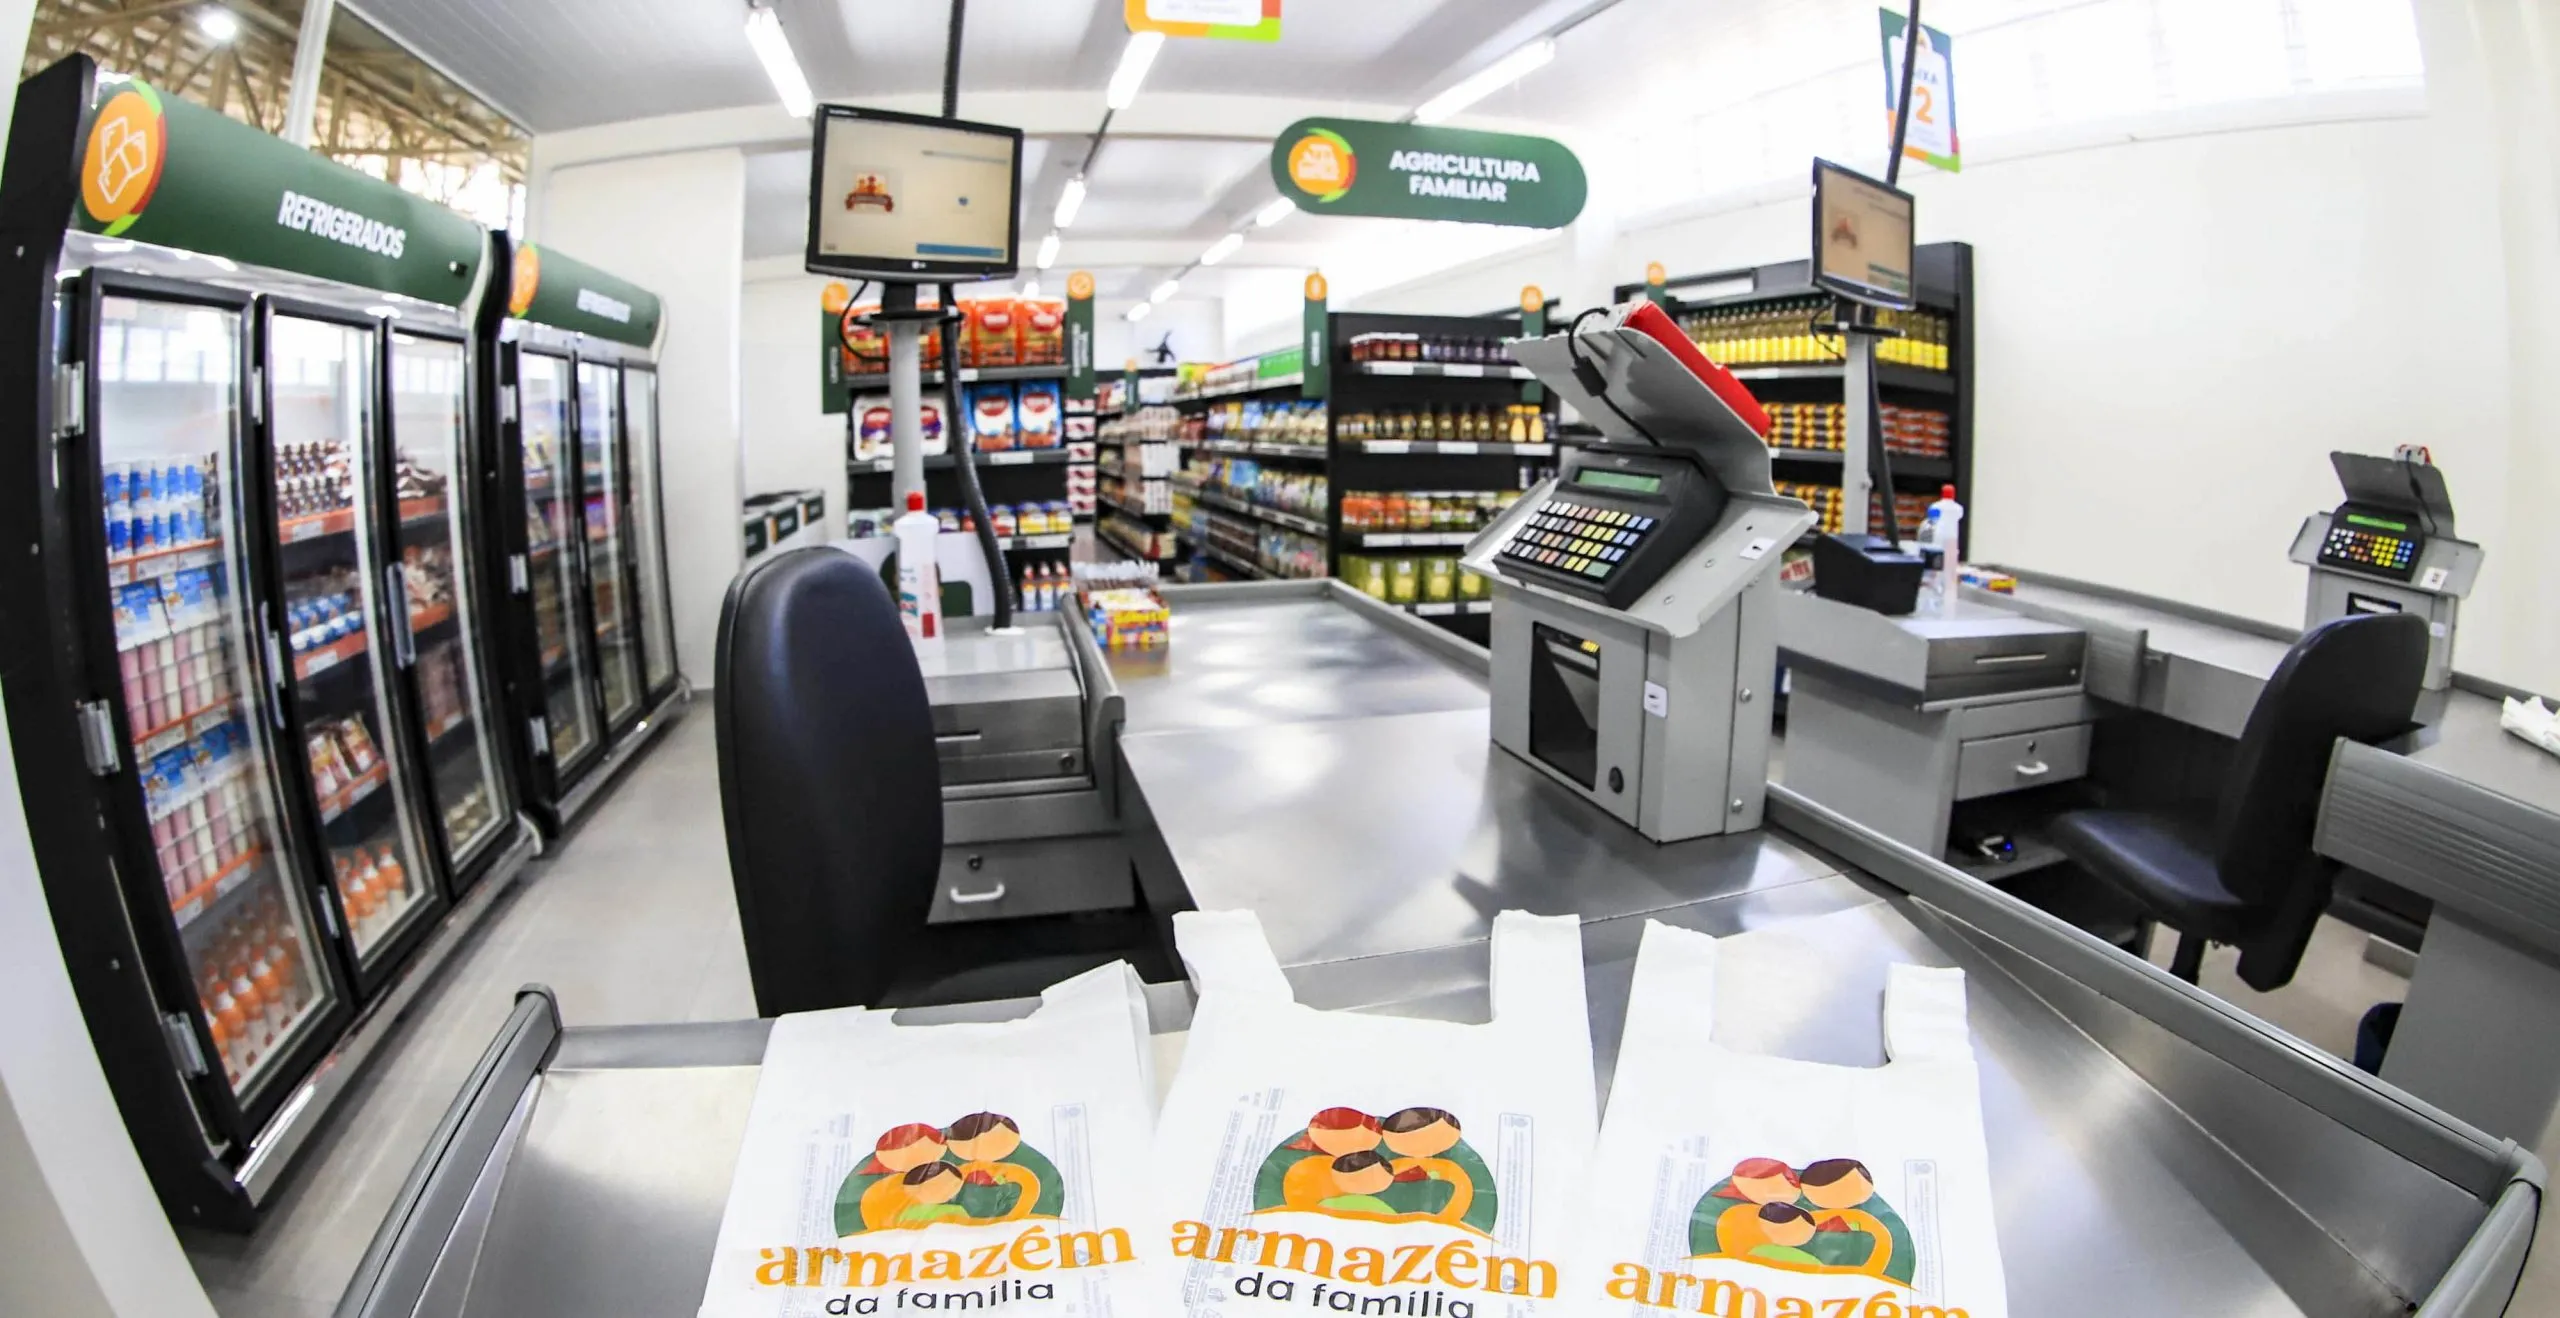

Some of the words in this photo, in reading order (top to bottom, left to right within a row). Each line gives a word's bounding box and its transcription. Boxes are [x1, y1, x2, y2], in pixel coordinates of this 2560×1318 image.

[1914, 85, 1935, 125] 2
[1389, 150, 1541, 183] AGRICULTURA
[1409, 174, 1507, 202] FAMILIAR
[277, 190, 406, 260] REFRIGERADOS
[755, 1224, 1139, 1288] armazém
[1171, 1218, 1558, 1299] armazém
[825, 1294, 879, 1315] da
[897, 1279, 1054, 1310] família
[1234, 1272, 1294, 1301] da
[1312, 1283, 1474, 1318] família
